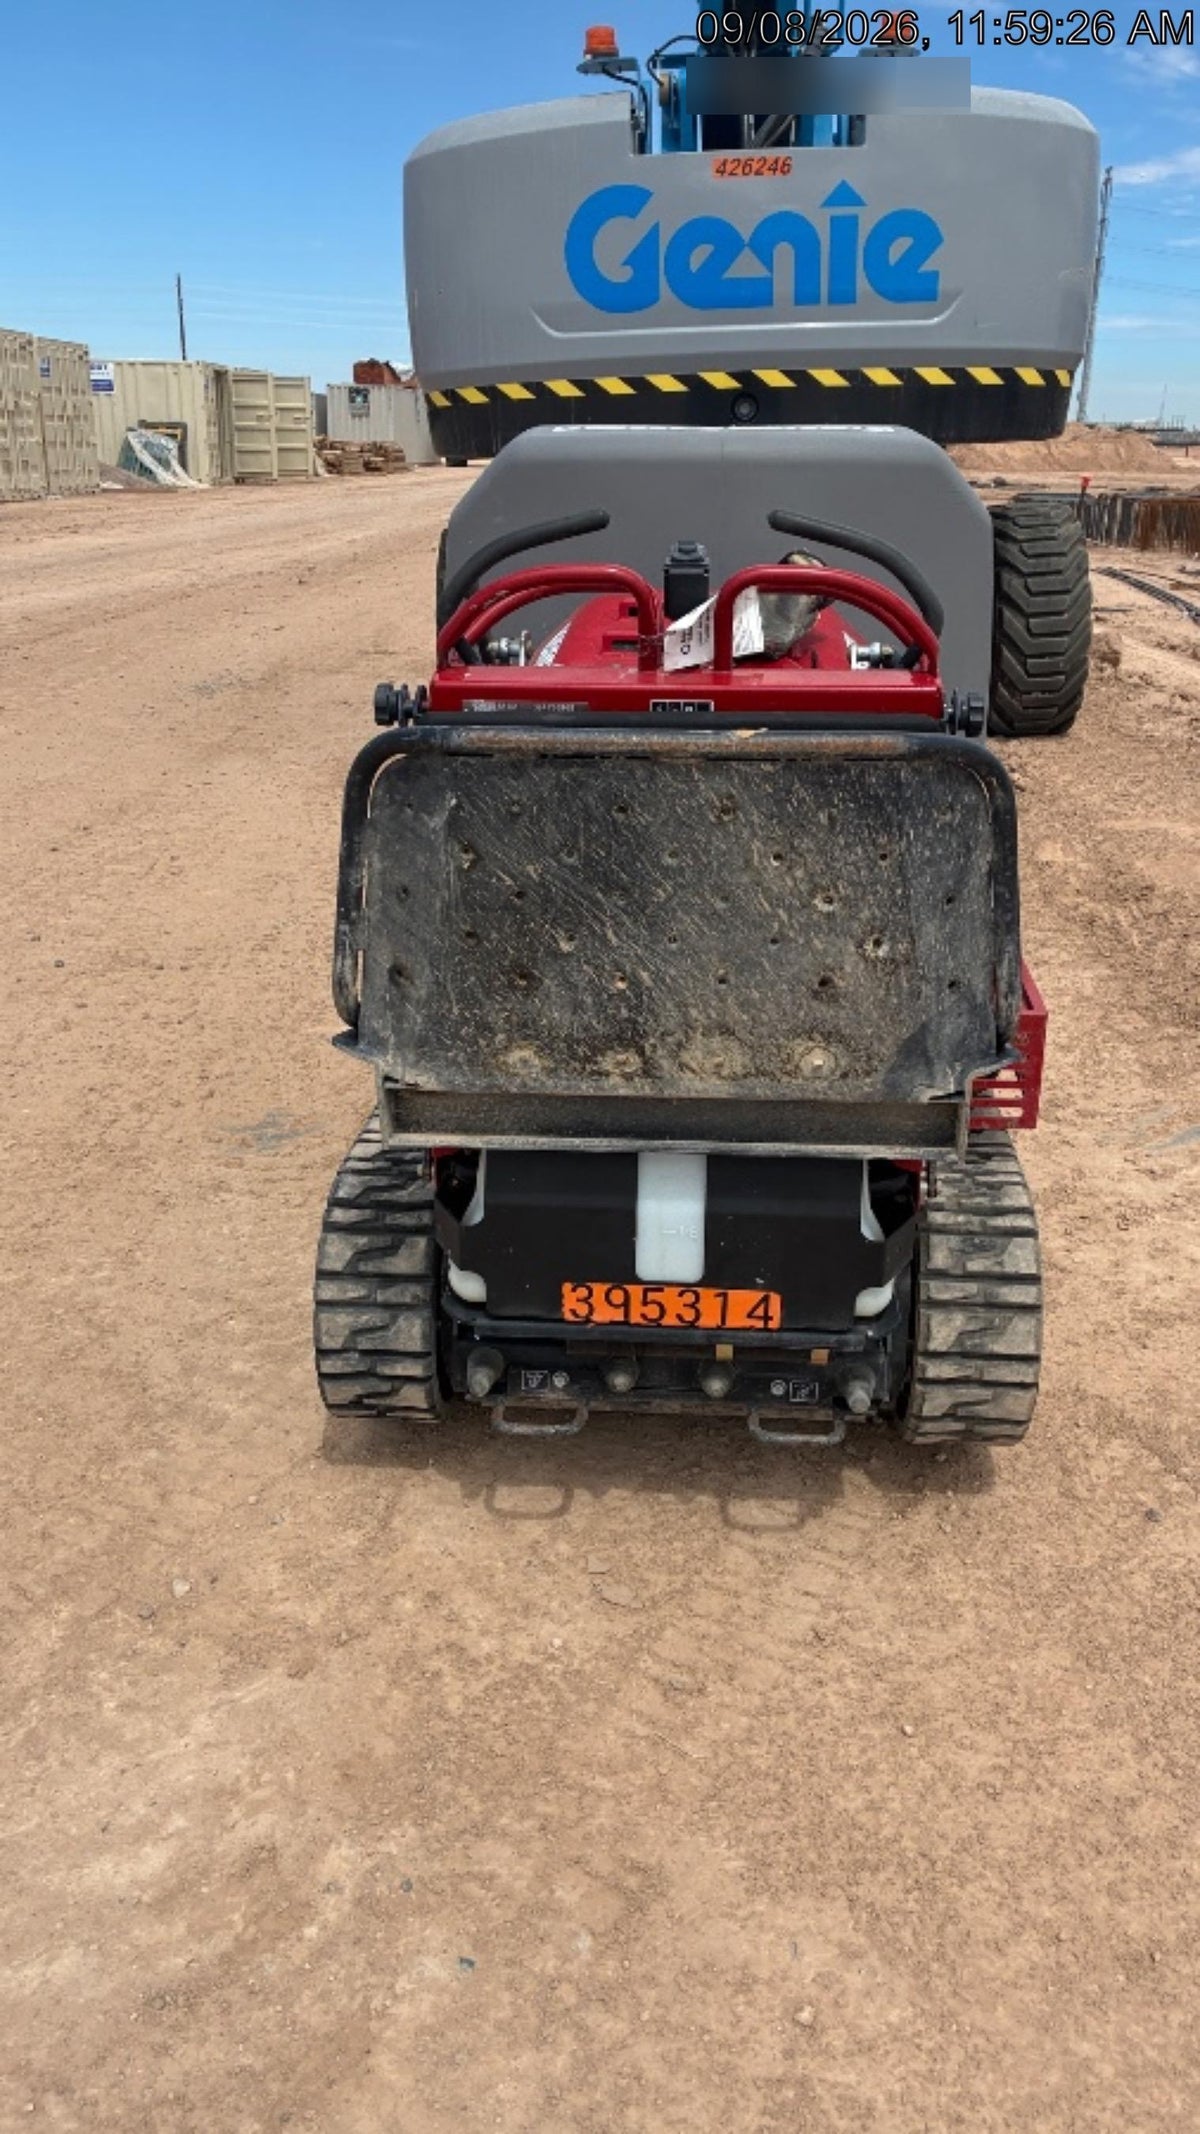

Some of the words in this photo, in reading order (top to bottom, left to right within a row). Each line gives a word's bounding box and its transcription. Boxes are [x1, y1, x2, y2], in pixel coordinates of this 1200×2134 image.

[715, 156, 793, 176] 426246
[564, 179, 944, 314] Genie
[569, 1285, 774, 1330] 395314
